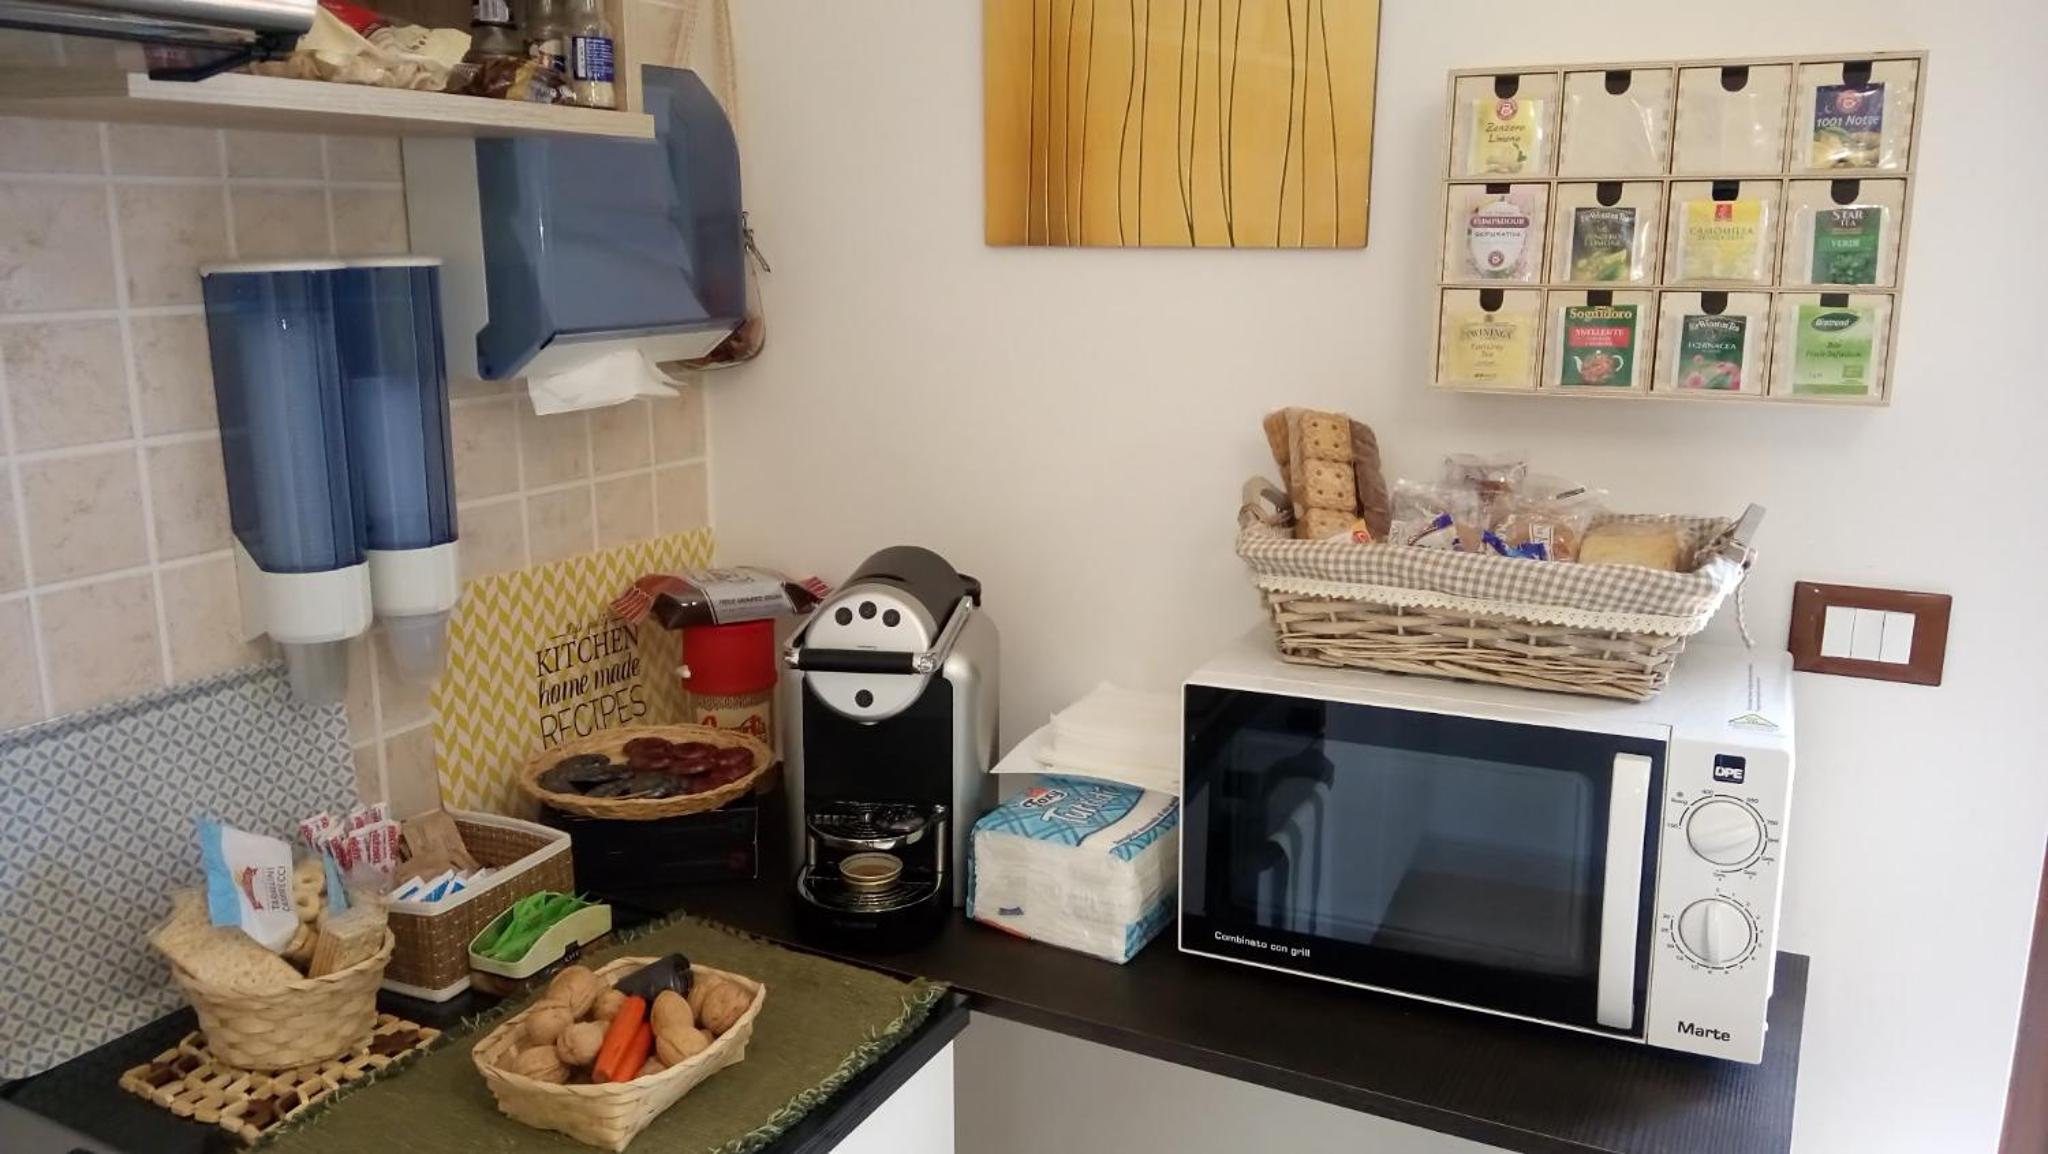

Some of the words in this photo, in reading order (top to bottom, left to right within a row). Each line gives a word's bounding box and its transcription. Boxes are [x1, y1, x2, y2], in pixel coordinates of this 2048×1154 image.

[1817, 117, 1843, 127] 1001
[1832, 210, 1864, 220] STAR
[537, 623, 639, 677] KITCHEN
[539, 674, 589, 709] home
[594, 651, 640, 690] made
[540, 684, 647, 751] RECIPES
[1714, 765, 1744, 780] DPE
[1214, 930, 1268, 949] Combinato
[1270, 943, 1289, 953] con
[1291, 947, 1311, 958] grill
[1677, 1020, 1731, 1042] Marte
